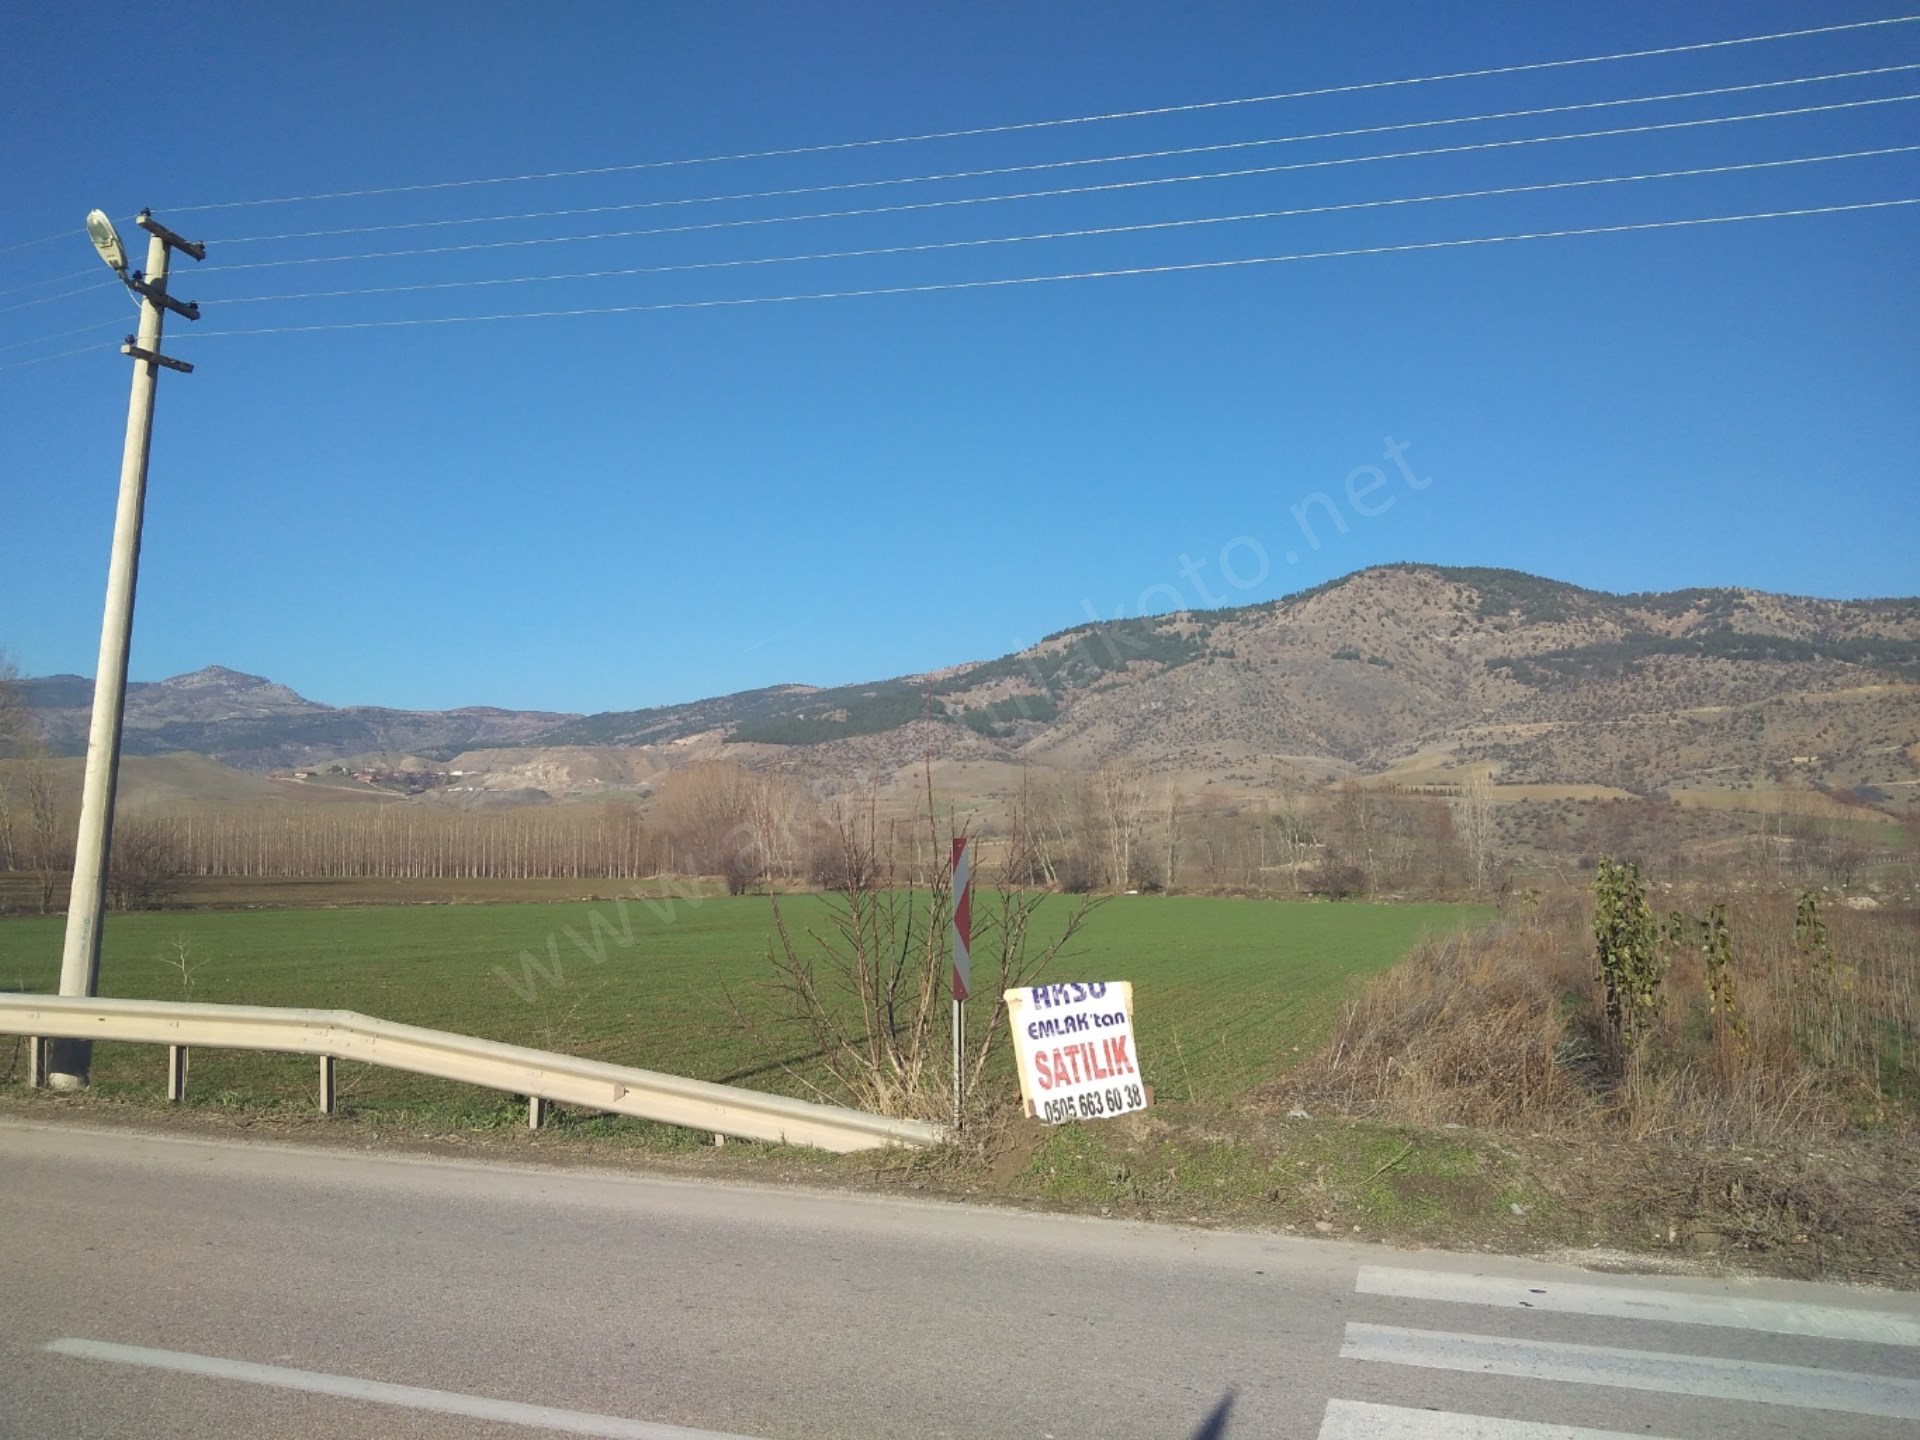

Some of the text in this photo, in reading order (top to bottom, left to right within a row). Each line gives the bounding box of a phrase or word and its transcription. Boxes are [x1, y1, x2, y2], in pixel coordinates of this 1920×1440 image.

[1034, 1035, 1135, 1091] SATILIK
[1044, 1083, 1142, 1124] 0505 663 60 38
